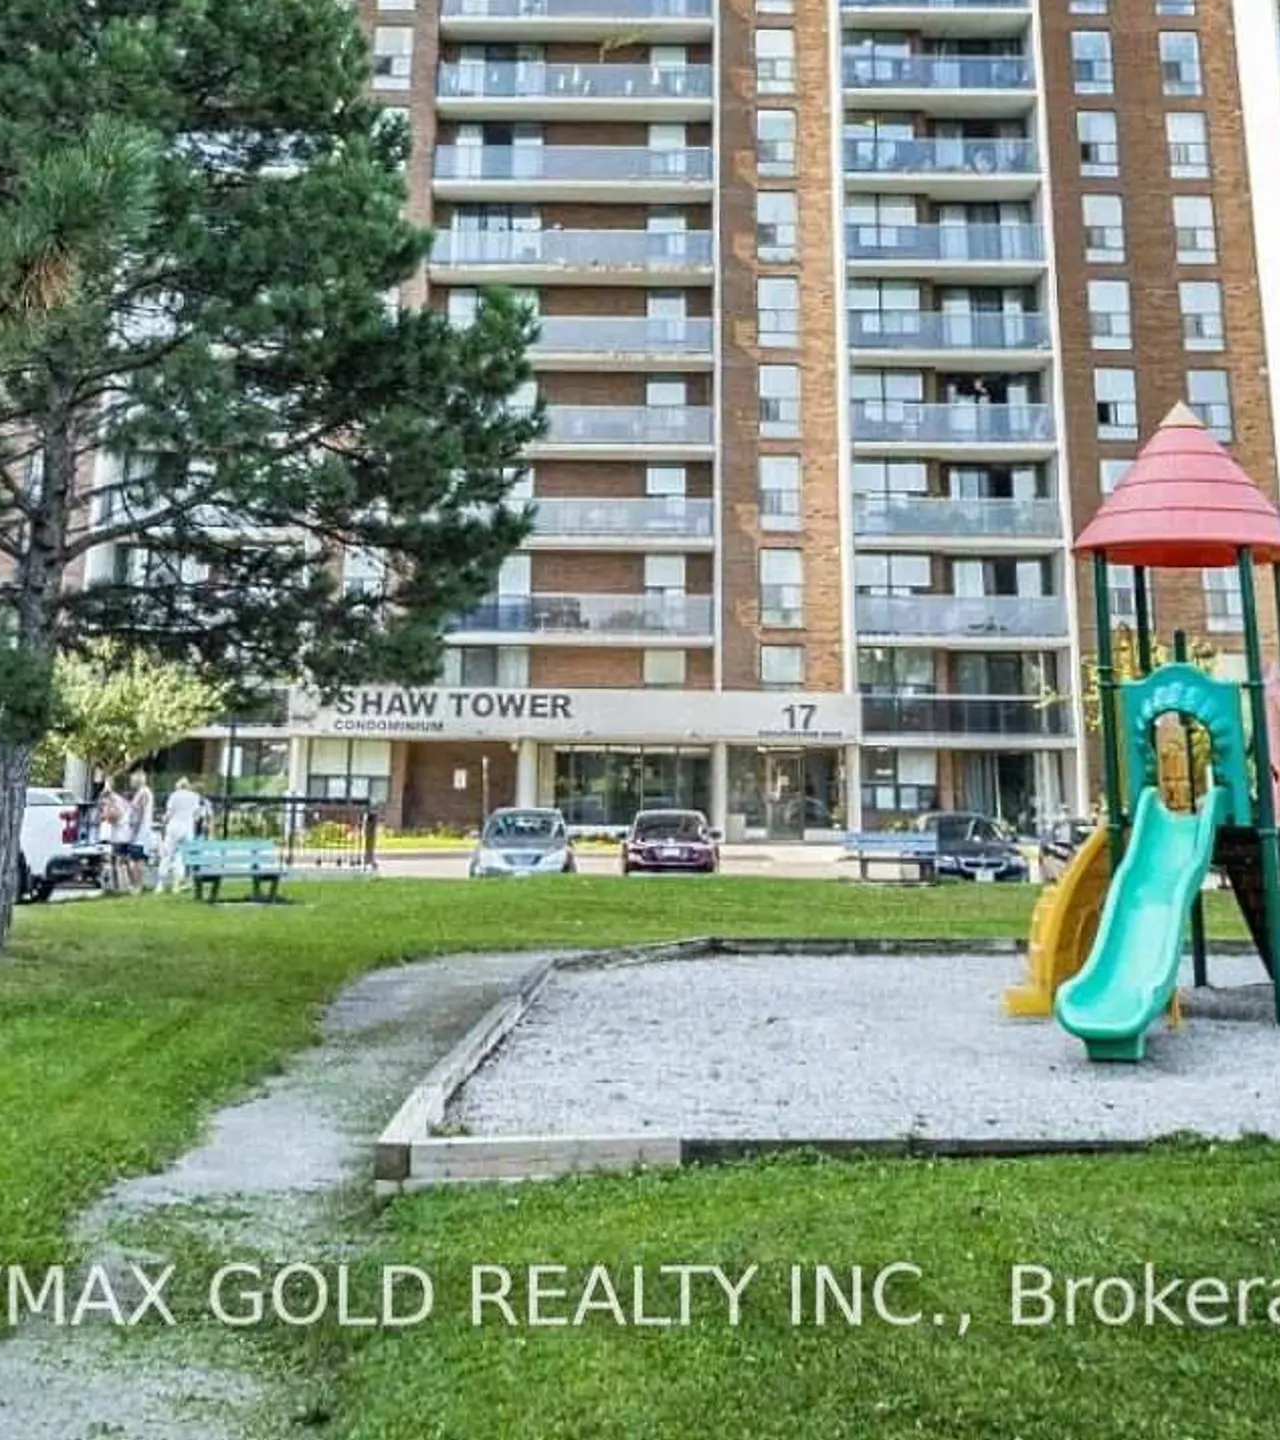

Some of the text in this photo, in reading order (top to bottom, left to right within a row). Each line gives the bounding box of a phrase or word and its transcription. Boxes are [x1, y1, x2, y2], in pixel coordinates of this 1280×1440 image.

[336, 690, 572, 719] SHAW TOWER
[783, 704, 816, 729] 17
[334, 719, 444, 732] CONDOMINIUM
